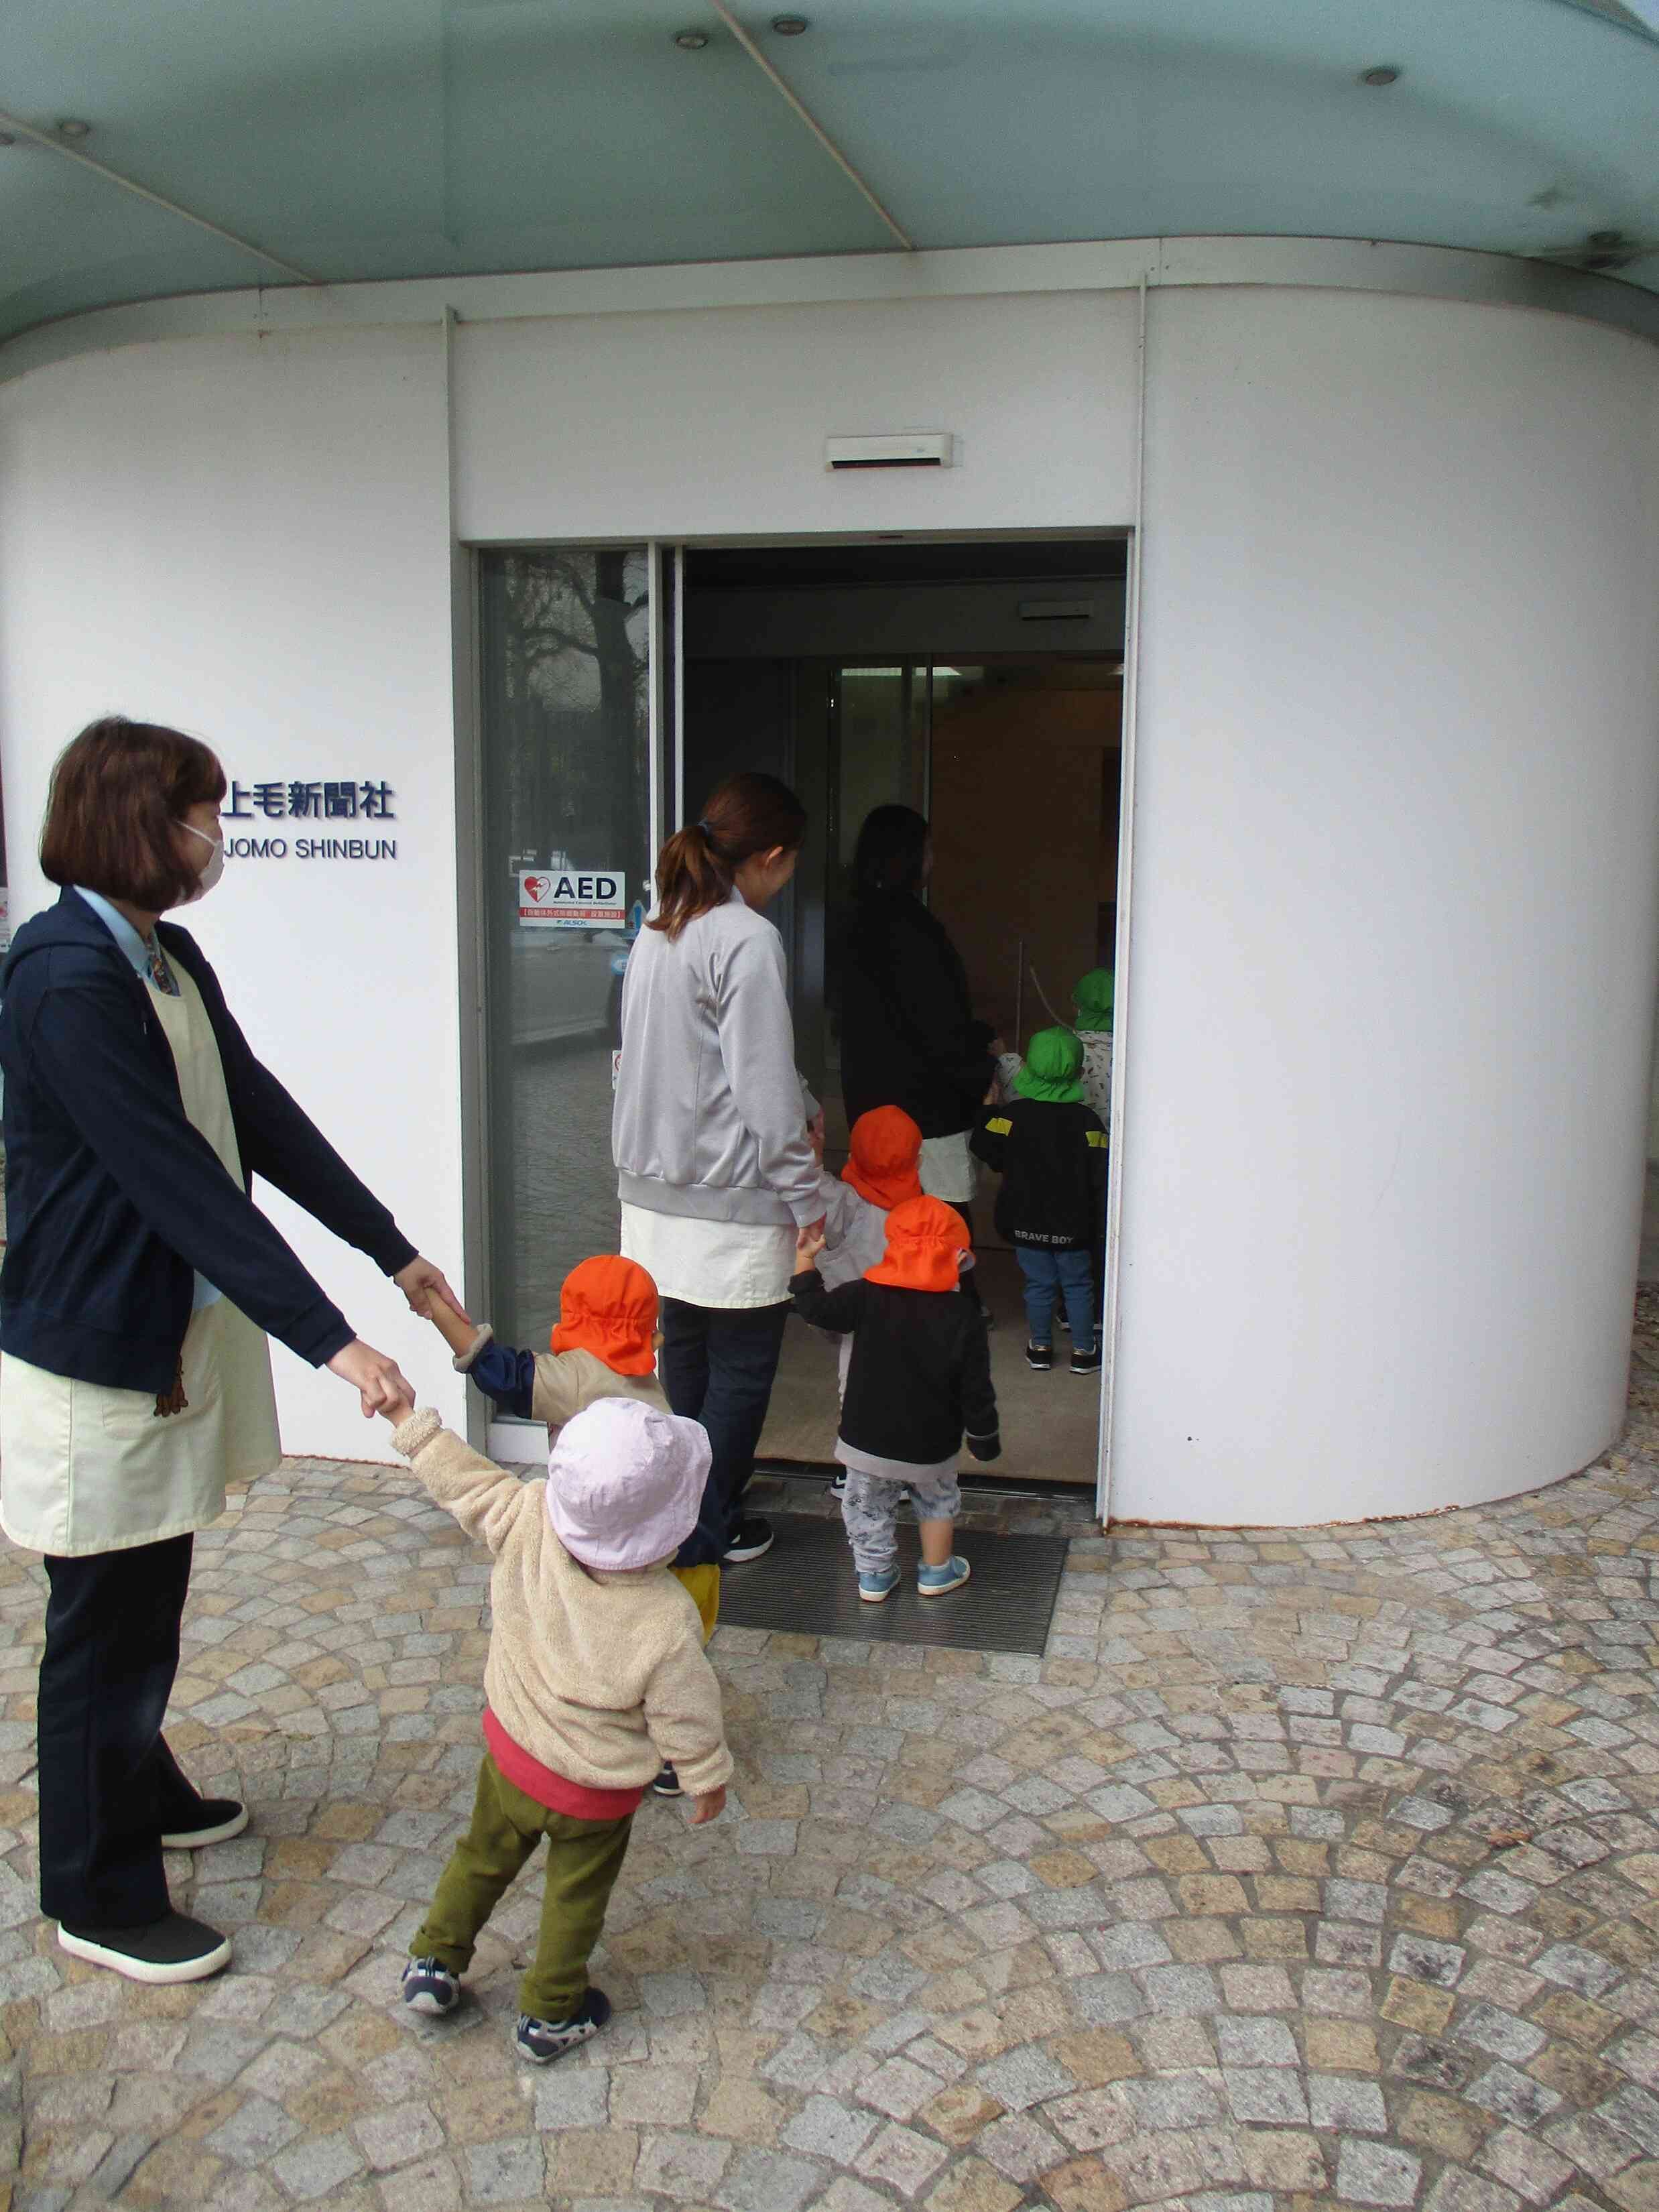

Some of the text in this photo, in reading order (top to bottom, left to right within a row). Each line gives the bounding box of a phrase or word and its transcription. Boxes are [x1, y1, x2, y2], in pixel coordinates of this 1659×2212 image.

[222, 781, 395, 818] 上毛新聞社
[224, 838, 397, 859] JOMO SHINBUN
[554, 876, 617, 900] AED
[1014, 1230, 1072, 1244] BRAVE BOY
